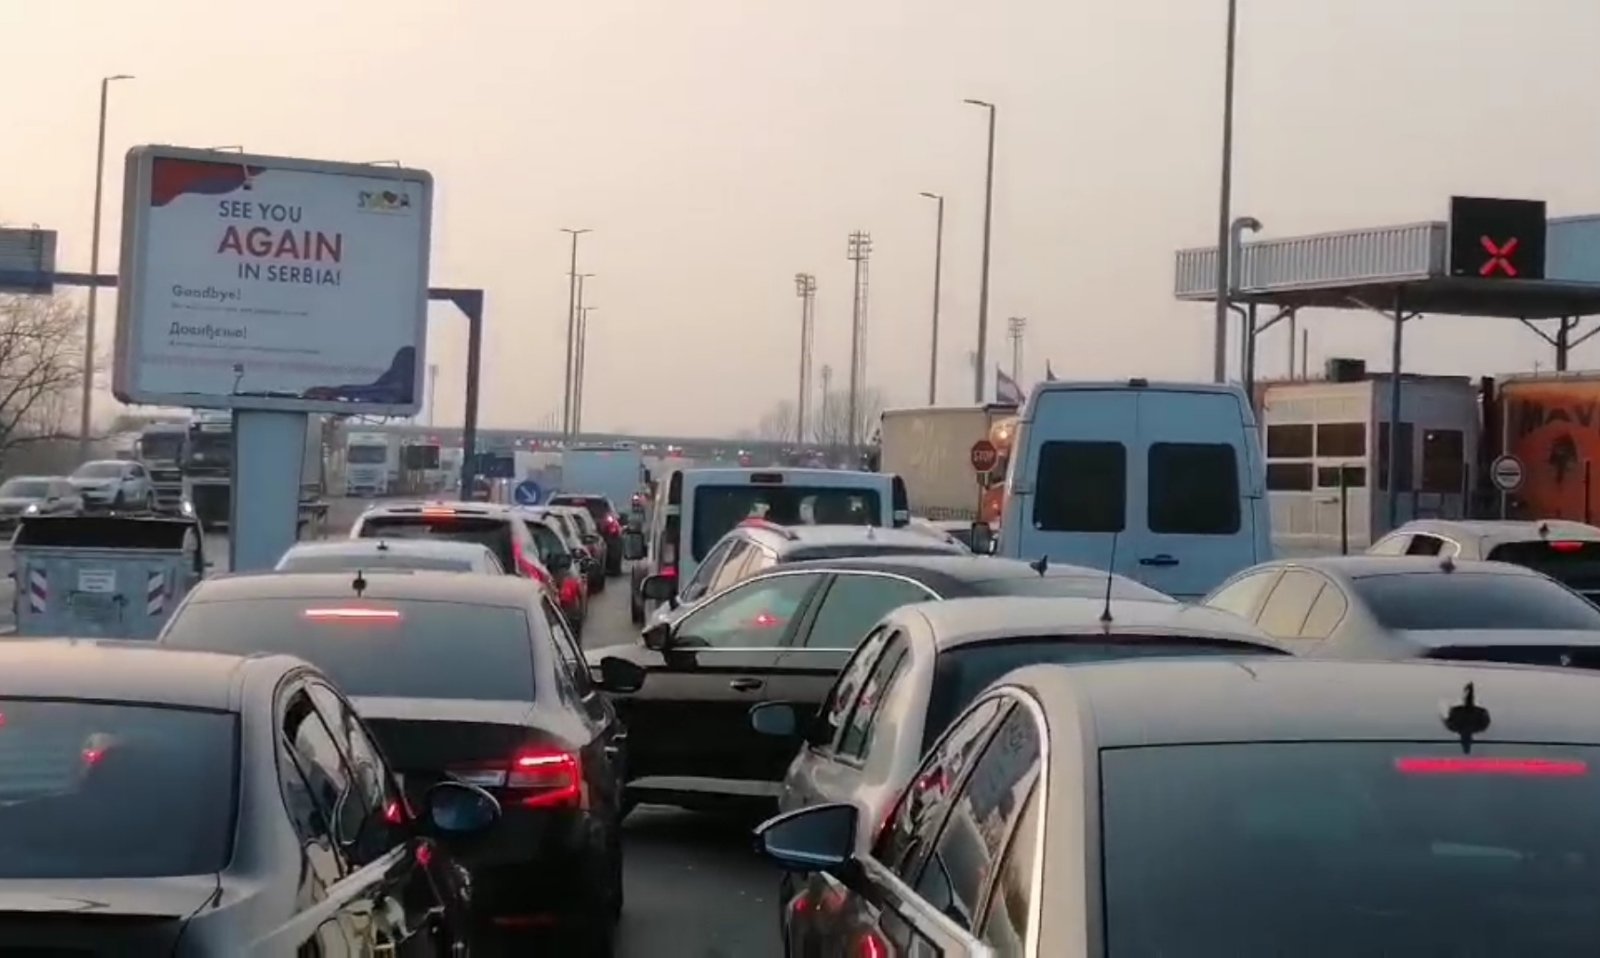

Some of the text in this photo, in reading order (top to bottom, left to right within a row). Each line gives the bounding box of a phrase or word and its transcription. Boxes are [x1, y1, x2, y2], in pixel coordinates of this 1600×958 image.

[219, 200, 302, 223] SEE YOU
[217, 225, 342, 263] AGAIN
[238, 262, 341, 286] IN SERBIA!
[172, 284, 241, 302] Goodbye!
[974, 449, 995, 462] STOP
